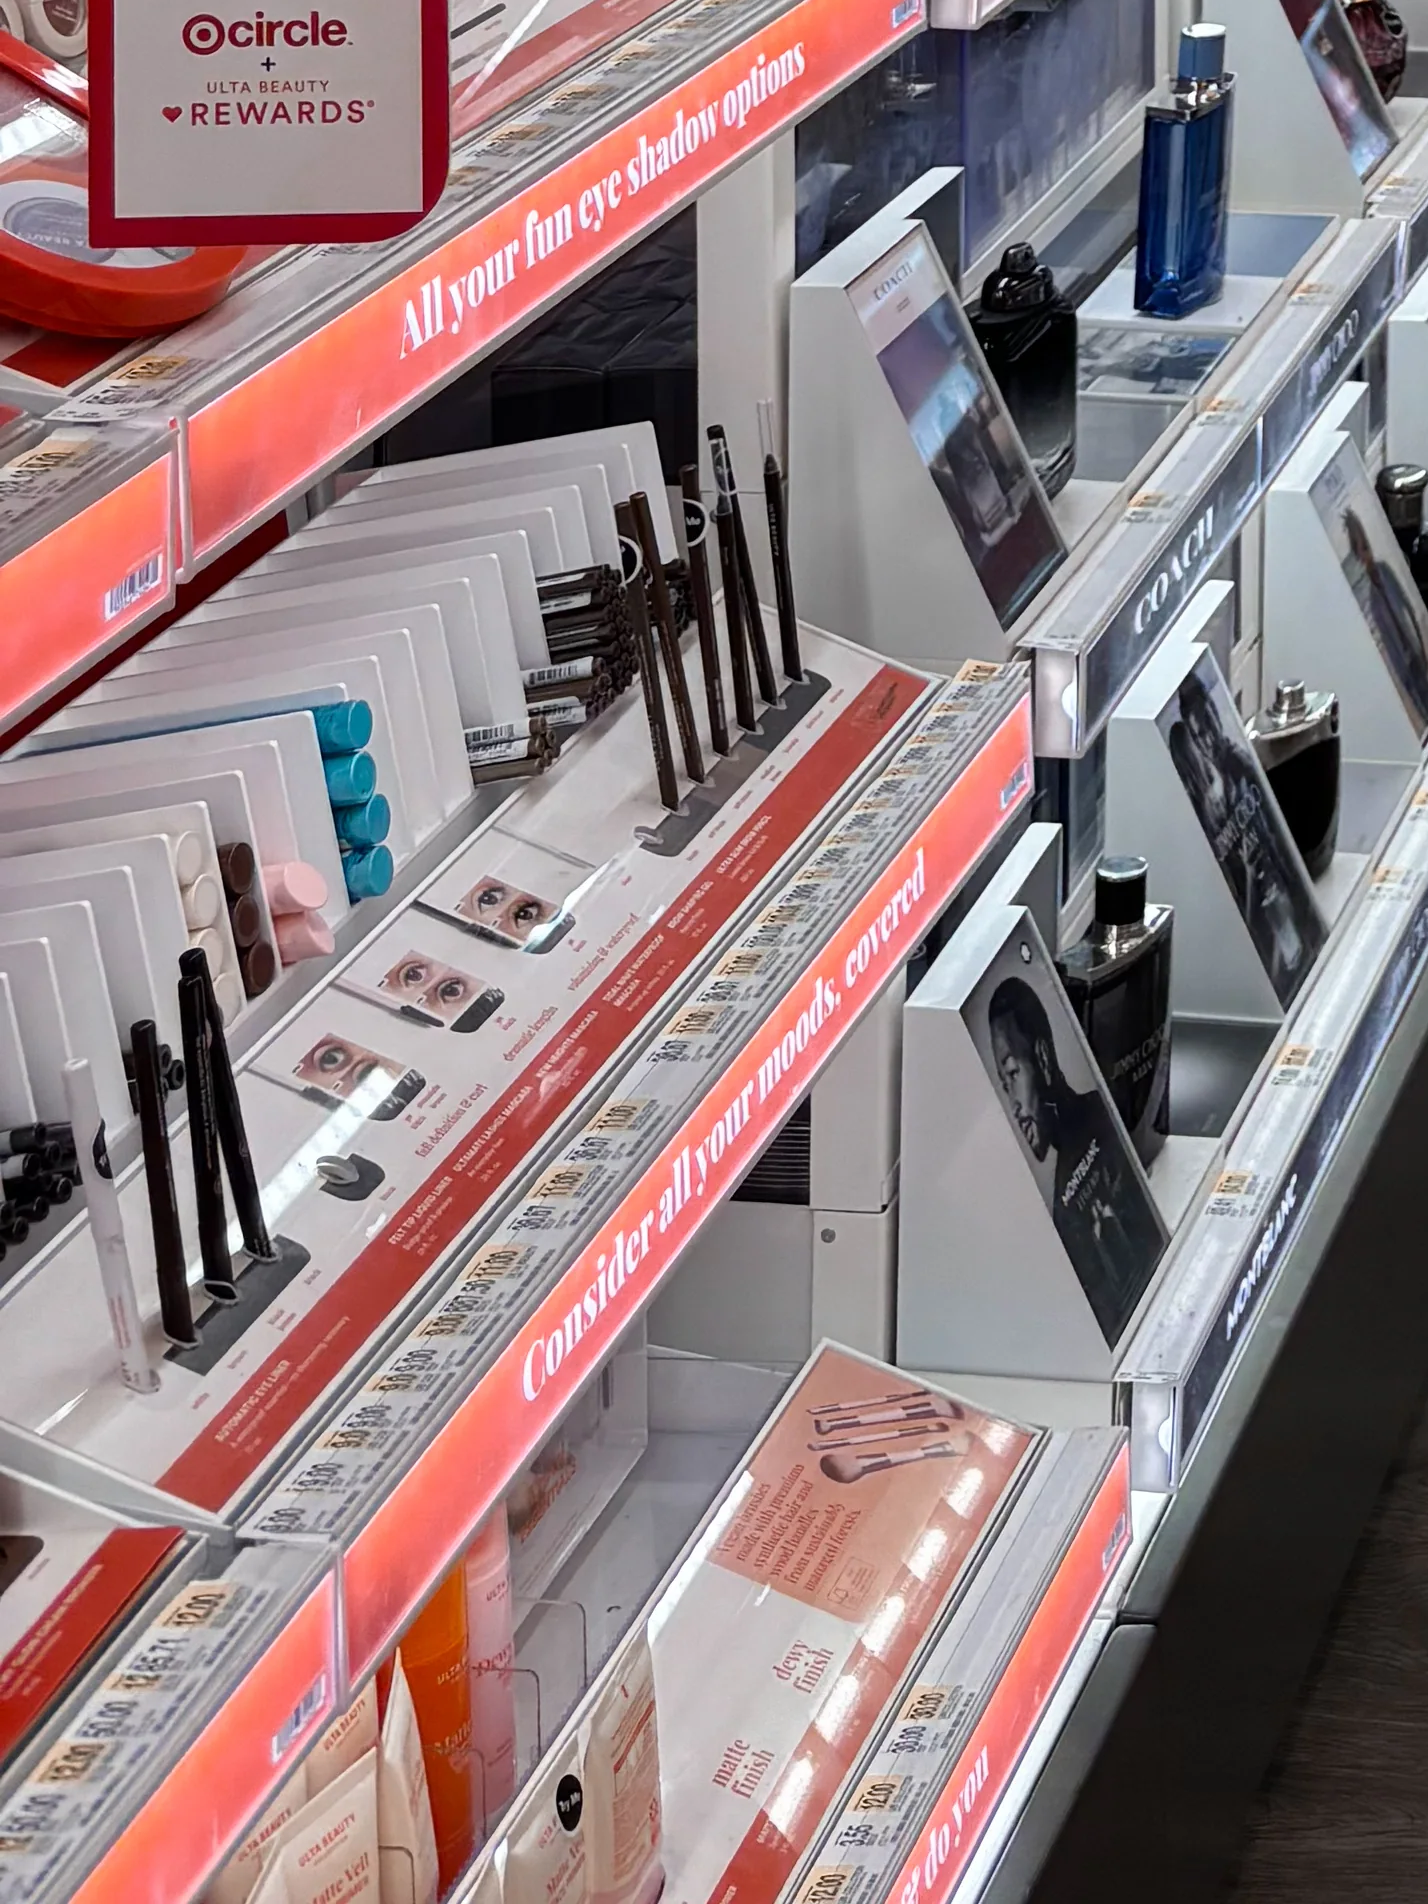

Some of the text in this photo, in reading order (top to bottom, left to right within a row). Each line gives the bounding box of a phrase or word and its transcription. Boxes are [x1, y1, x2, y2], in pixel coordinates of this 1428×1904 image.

[207, 80, 330, 94] ULTA BEAUTY
[260, 57, 276, 72] +
[399, 41, 808, 360] All your fun eye shadow options
[873, 262, 913, 301] COACH
[1134, 506, 1214, 635] COACH
[1234, 783, 1262, 829] CHOO
[570, 1009, 600, 1040] MASCARA
[501, 1084, 534, 1121] MASCARA
[521, 1210, 655, 1402] Consider
[658, 1140, 692, 1236] all
[696, 1072, 757, 1197] your
[757, 975, 843, 1105] moods,
[845, 847, 928, 987] covered
[1061, 1138, 1101, 1207] MONTBLANC
[1225, 1173, 1298, 1341] MONTBLANC
[736, 1463, 806, 1564] made with premium
[753, 1514, 791, 1569] synthetic
[768, 1508, 820, 1578] wood handles
[782, 1501, 846, 1586] from sustainably
[803, 1538, 841, 1593] managed
[172, 1592, 226, 1628] 12.00
[436, 1663, 461, 1687] ULTA
[771, 1638, 835, 1695] dewy finish
[322, 1698, 367, 1753] ULTA BEAUTY
[711, 1738, 776, 1801] matte finish
[860, 1780, 898, 1812] 12.00
[557, 1798, 571, 1814] Try
[924, 1743, 991, 1890] do you
[236, 1807, 293, 1863] ULTA BEAUTY
[298, 1811, 358, 1870] ULTA BEAUTY
[311, 1872, 346, 1904] atte
[344, 1851, 371, 1884] Veil
